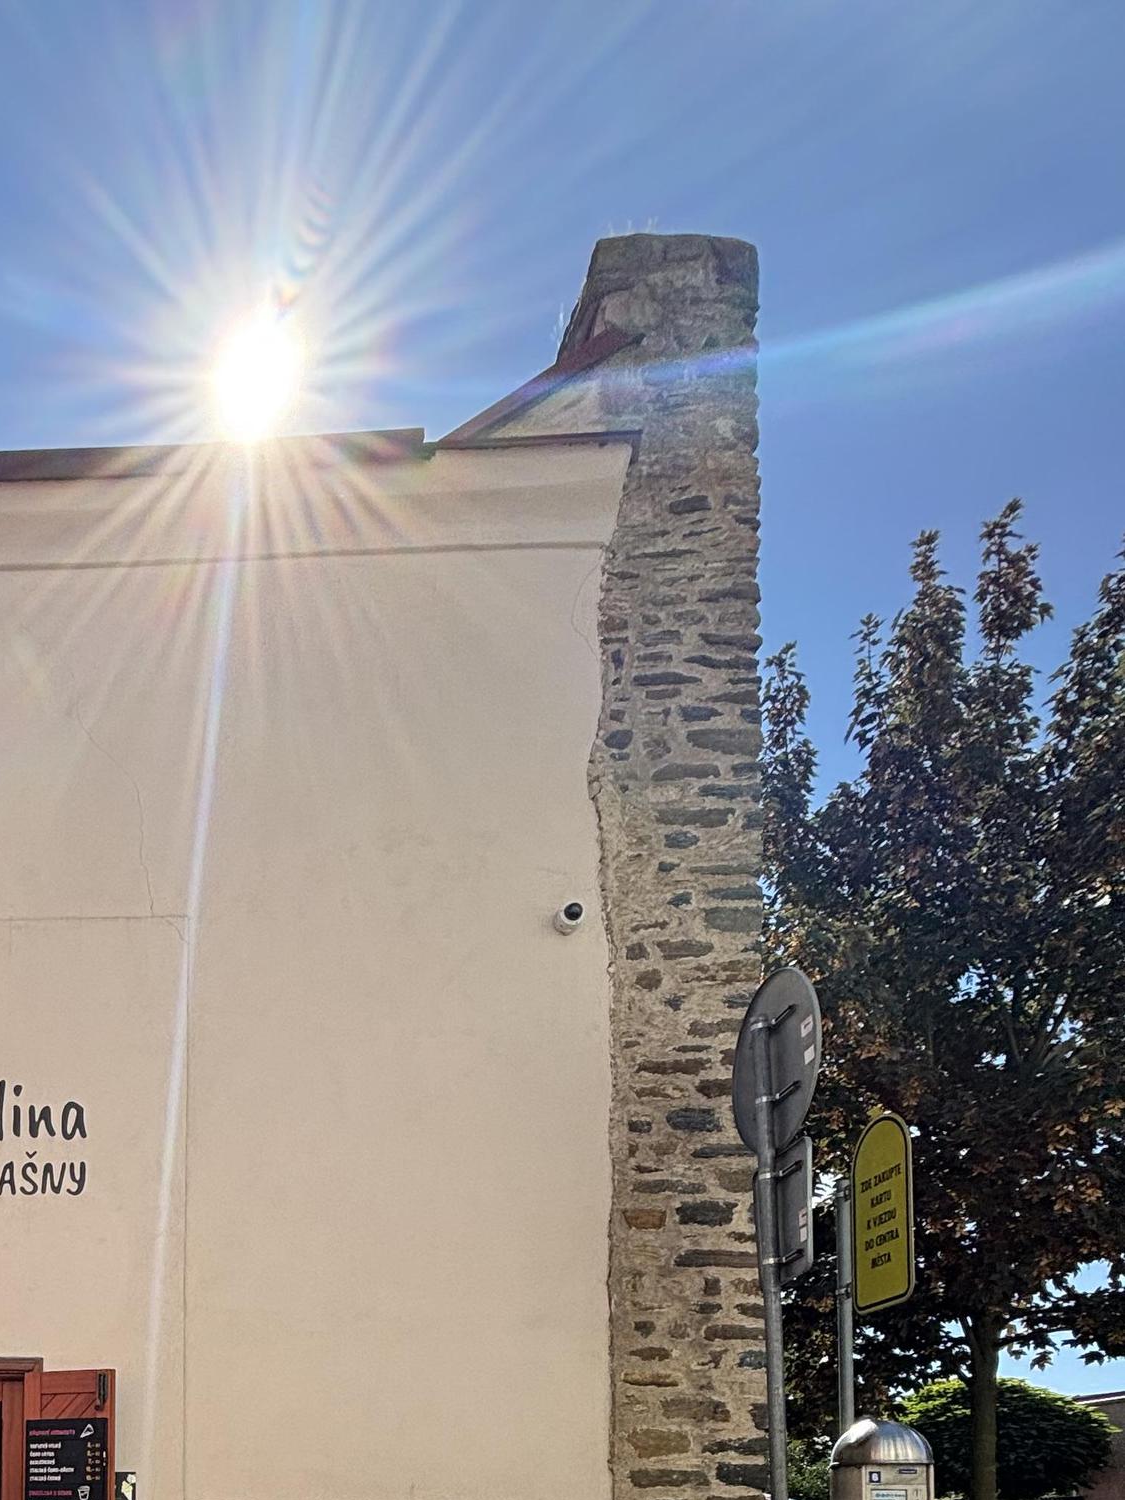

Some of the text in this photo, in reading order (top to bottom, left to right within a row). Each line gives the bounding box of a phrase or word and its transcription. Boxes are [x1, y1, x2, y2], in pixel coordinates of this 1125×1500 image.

[860, 1163, 902, 1193] ZDE ZAKUPTE
[871, 1189, 892, 1208] KARTU
[867, 1219, 872, 1230] K
[865, 1228, 900, 1252] DO CENTRA
